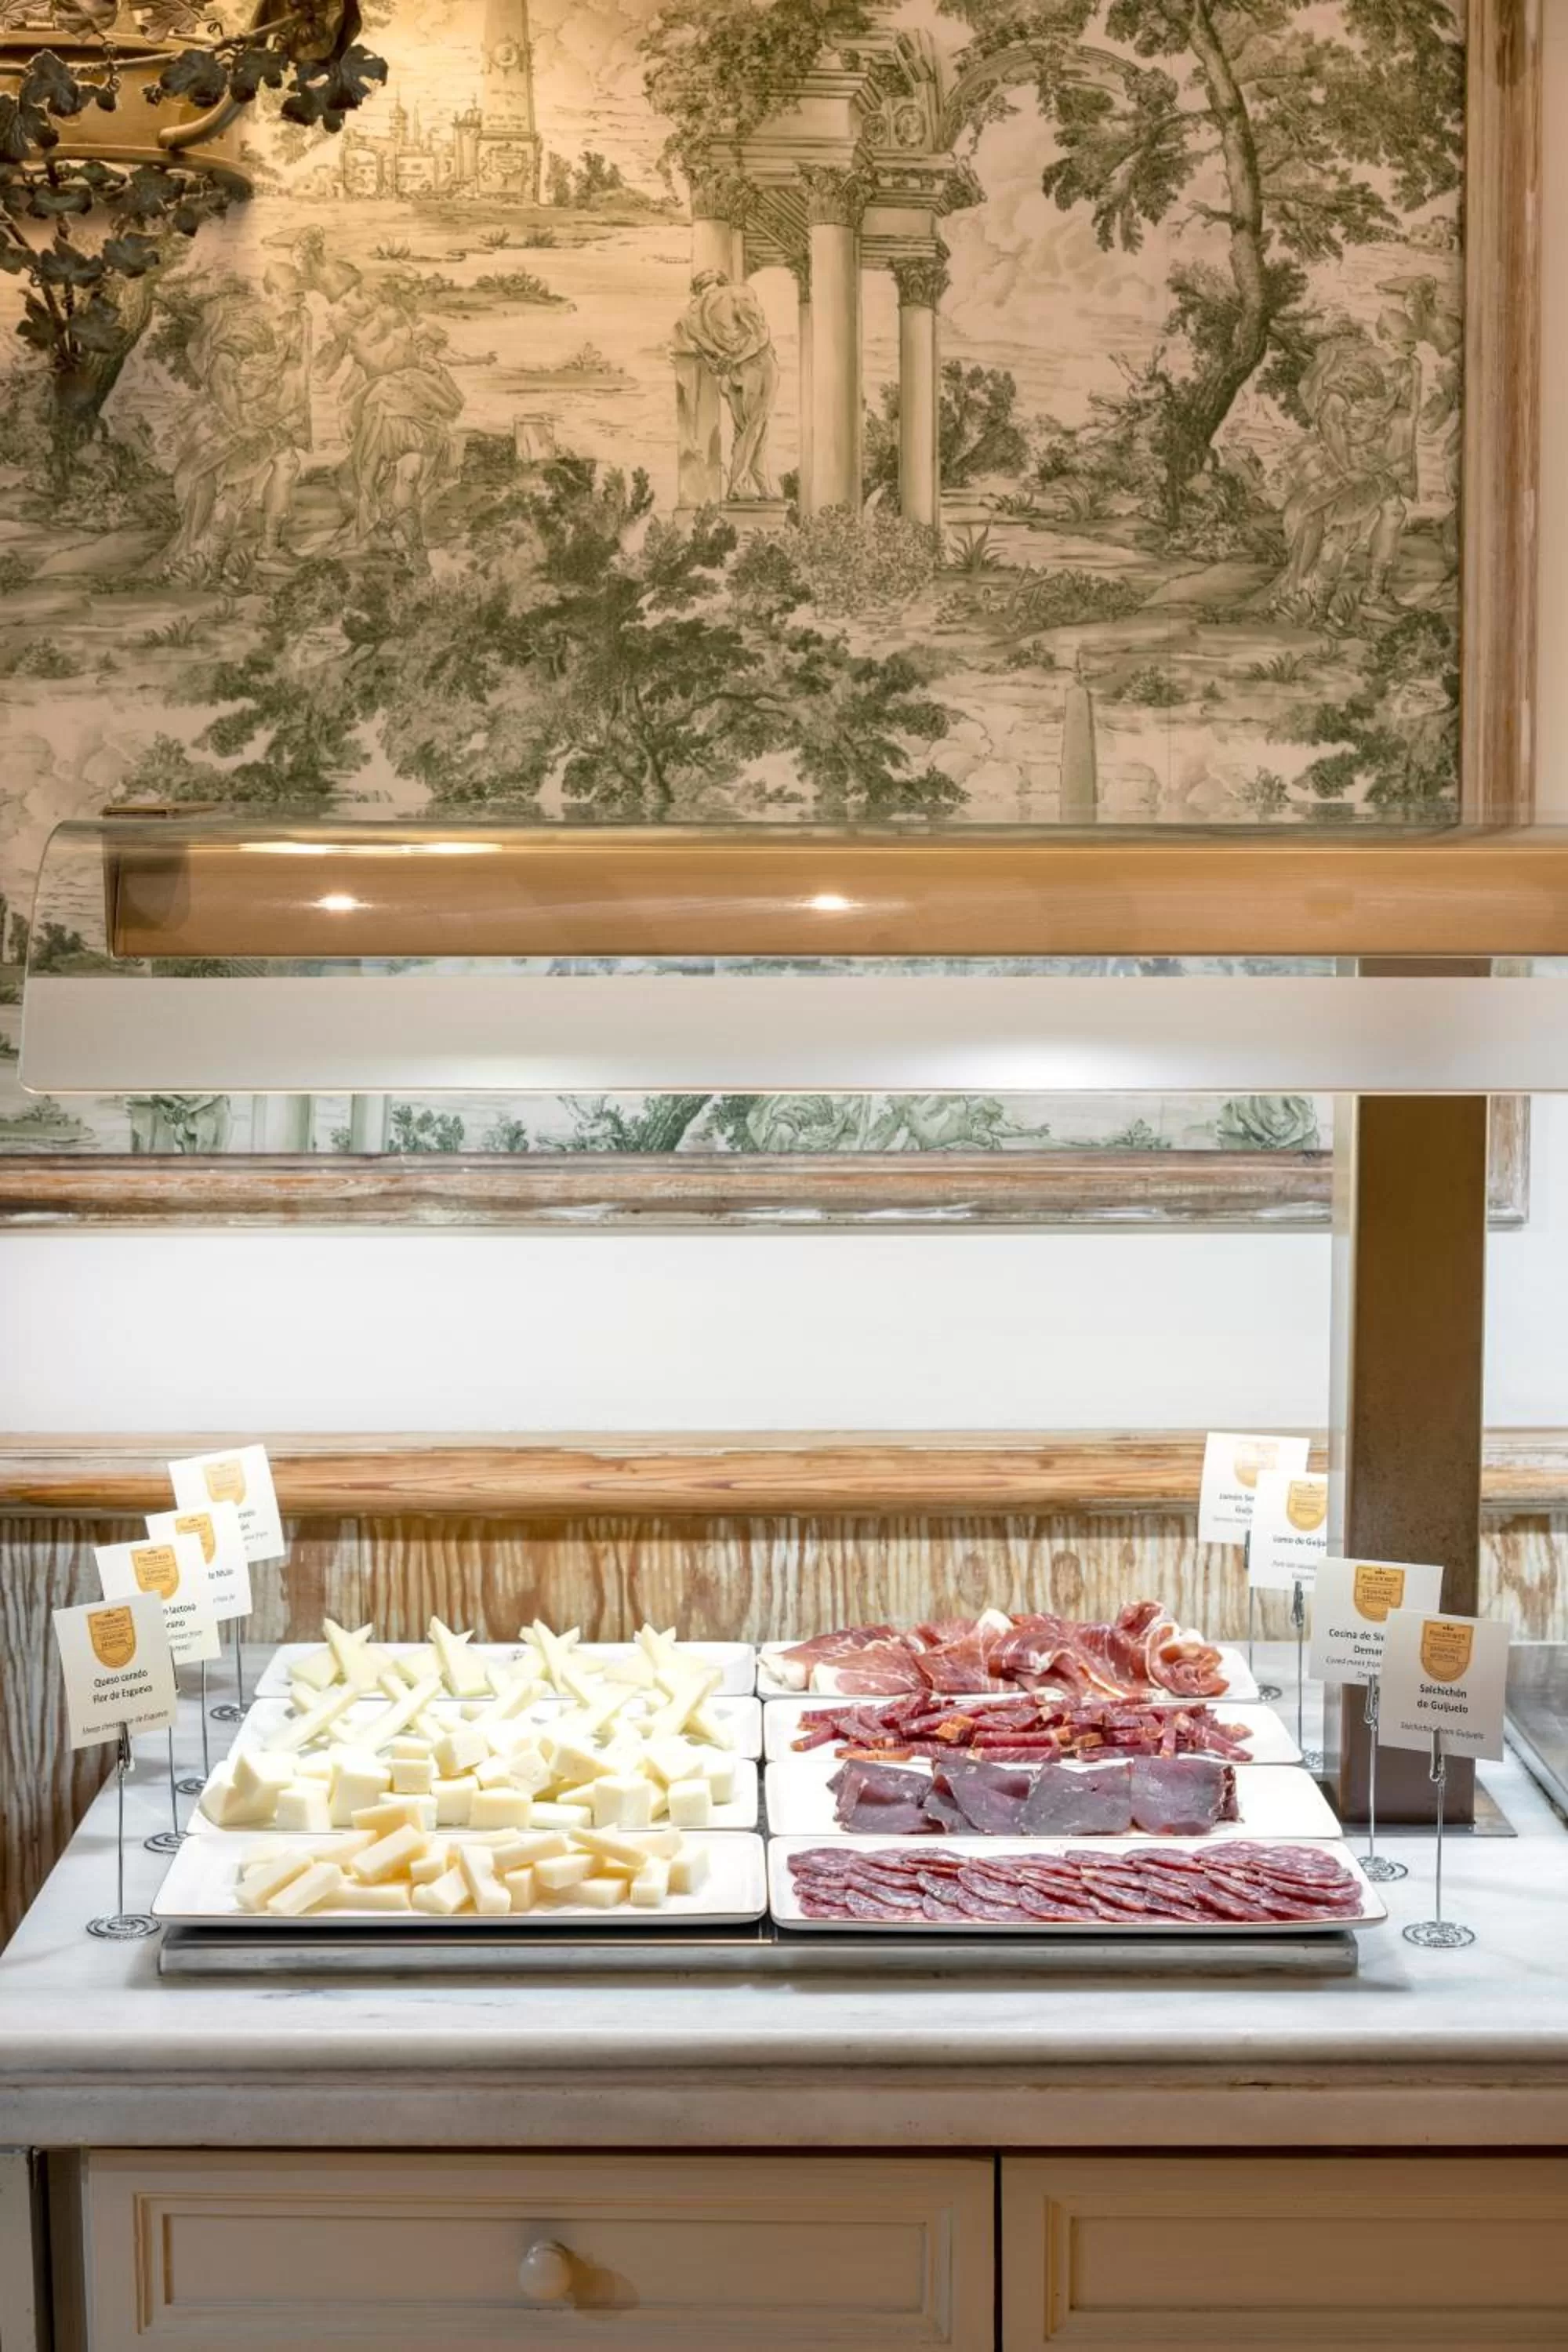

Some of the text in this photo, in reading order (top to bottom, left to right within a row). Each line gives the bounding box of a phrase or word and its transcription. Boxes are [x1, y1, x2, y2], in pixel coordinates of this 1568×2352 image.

[1329, 1628, 1357, 1639] Cecina
[1359, 1631, 1371, 1641] de
[94, 1675, 120, 1688] Queso
[93, 1693, 107, 1704] Flor
[110, 1690, 120, 1700] de
[1417, 1699, 1468, 1714] de Guijuelo
